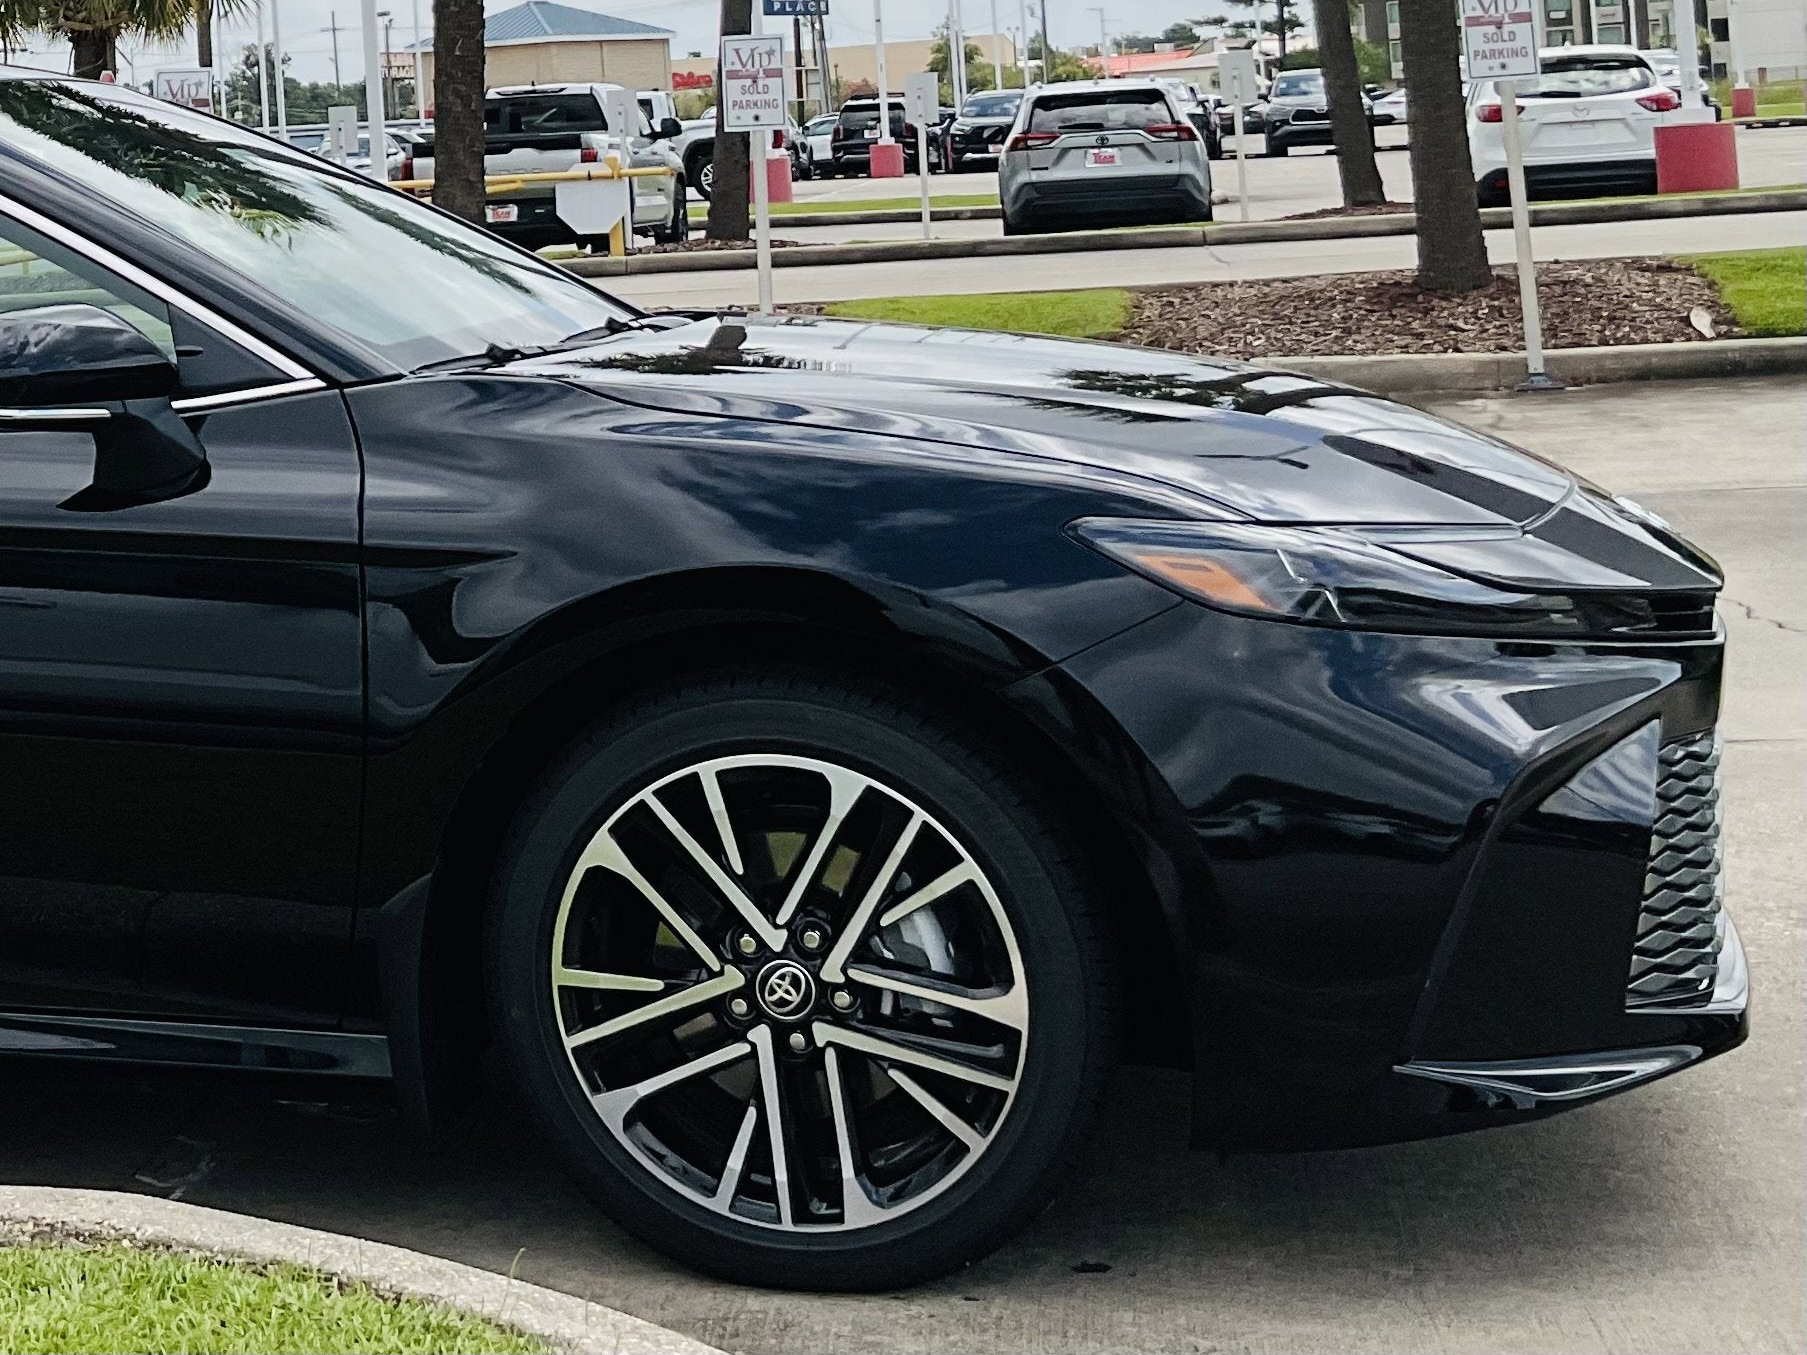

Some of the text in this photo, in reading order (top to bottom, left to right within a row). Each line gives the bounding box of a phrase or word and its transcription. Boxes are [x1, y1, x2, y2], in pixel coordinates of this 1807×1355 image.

[1483, 31, 1516, 44] SOLD
[1473, 46, 1528, 61] PARKING
[741, 84, 769, 95] SOLD
[732, 99, 779, 111] PARKING
